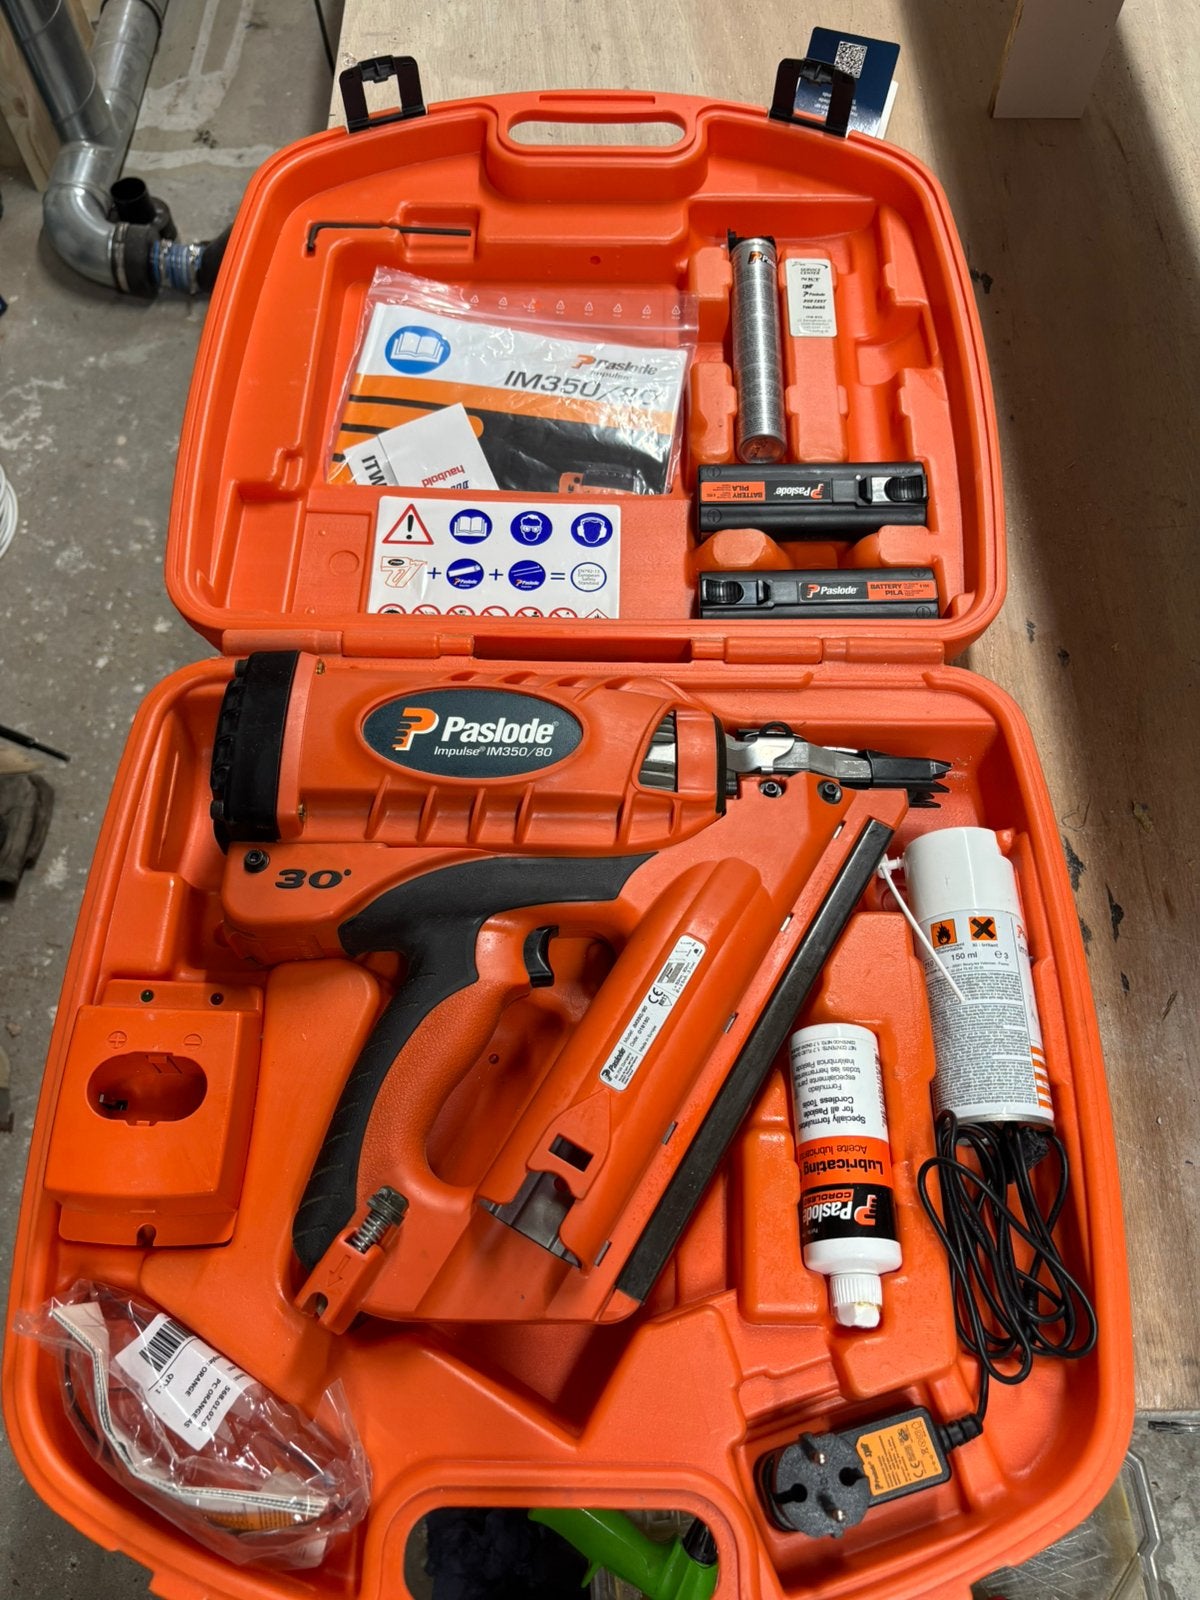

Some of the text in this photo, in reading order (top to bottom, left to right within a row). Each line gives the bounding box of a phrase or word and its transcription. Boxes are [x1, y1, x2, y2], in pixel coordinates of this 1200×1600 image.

[422, 464, 466, 488] haubold
[820, 586, 859, 595] Paslode
[486, 747, 552, 758] IM350/80
[952, 952, 966, 960] 150
[832, 1115, 866, 1124] Specially
[836, 1144, 868, 1154] Aceite
[803, 1158, 884, 1176] Lubricating
[185, 1366, 208, 1398] ORANGE
[213, 1378, 222, 1390] PC
[192, 1389, 214, 1420] ORANGE
